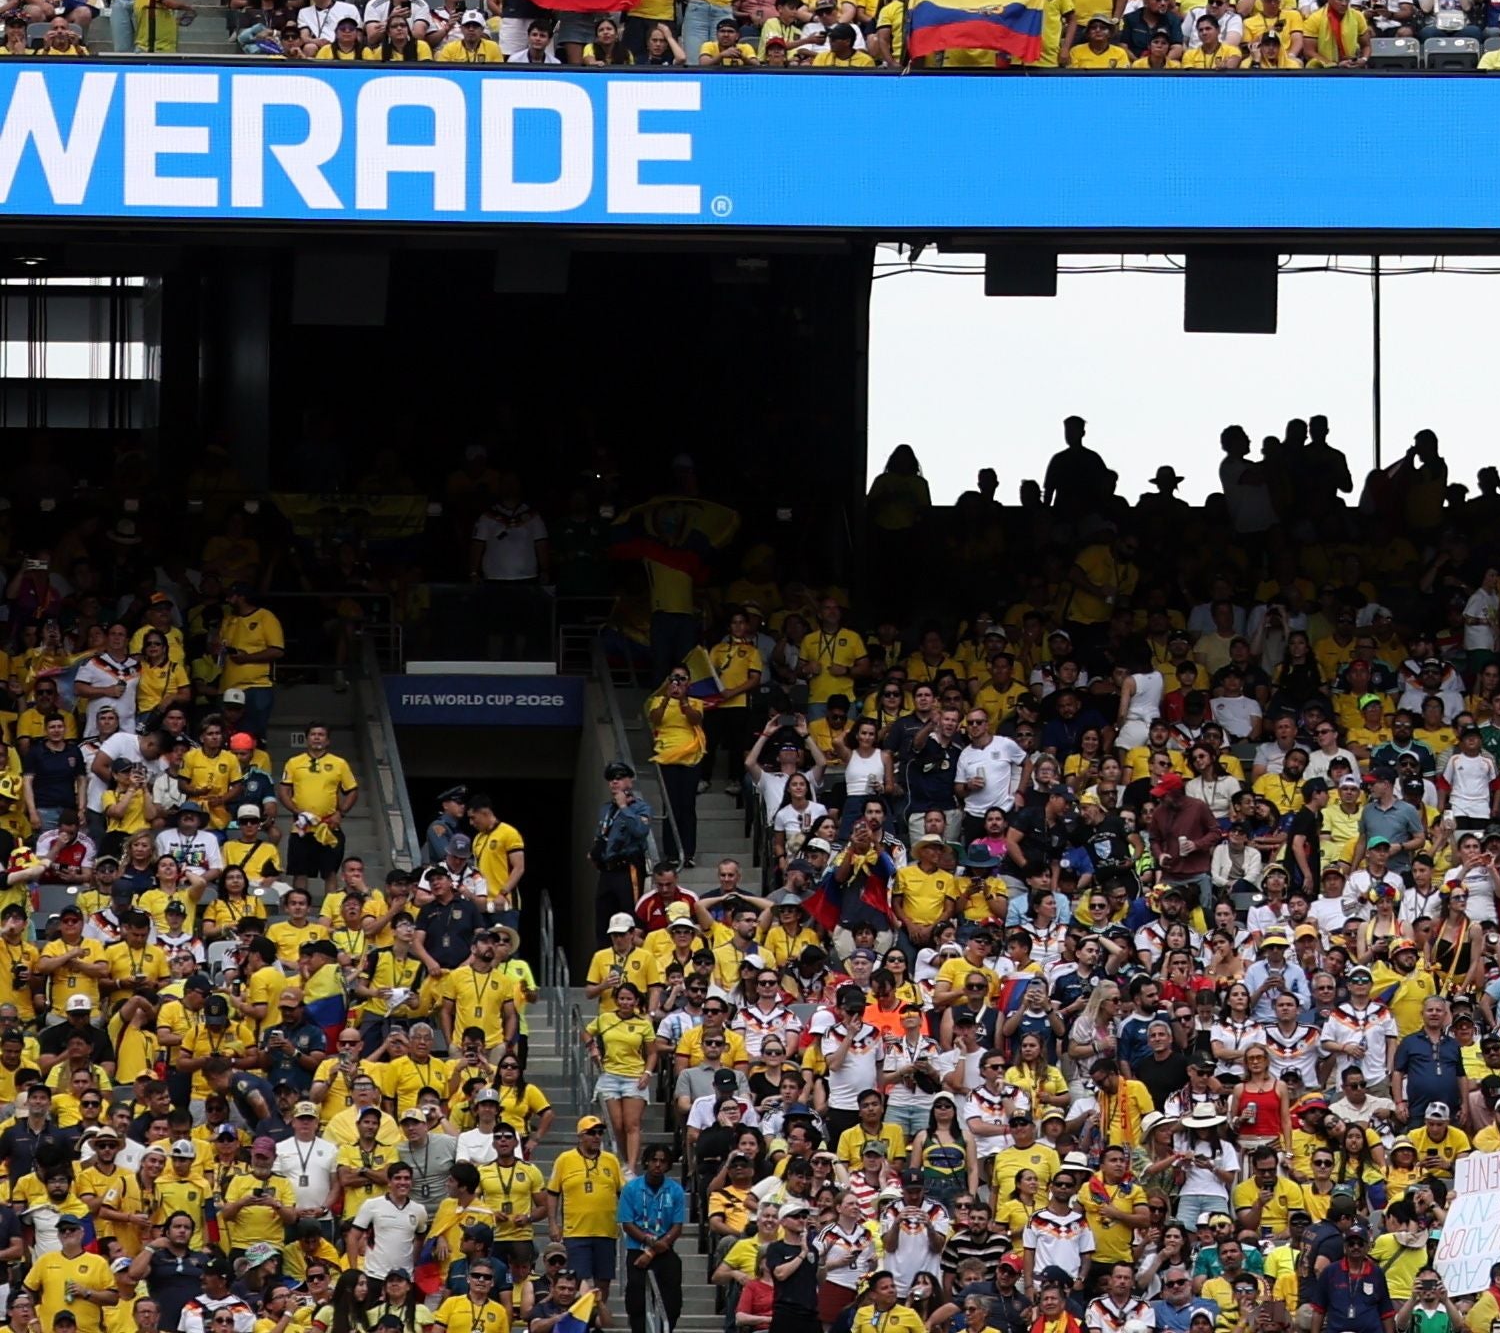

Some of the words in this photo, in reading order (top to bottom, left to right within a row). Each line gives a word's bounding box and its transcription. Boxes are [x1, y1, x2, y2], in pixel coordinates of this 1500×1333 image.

[401, 694, 432, 706] FIFA
[433, 694, 484, 706] WORLD
[485, 694, 514, 706] CUP
[515, 695, 565, 706] 2026
